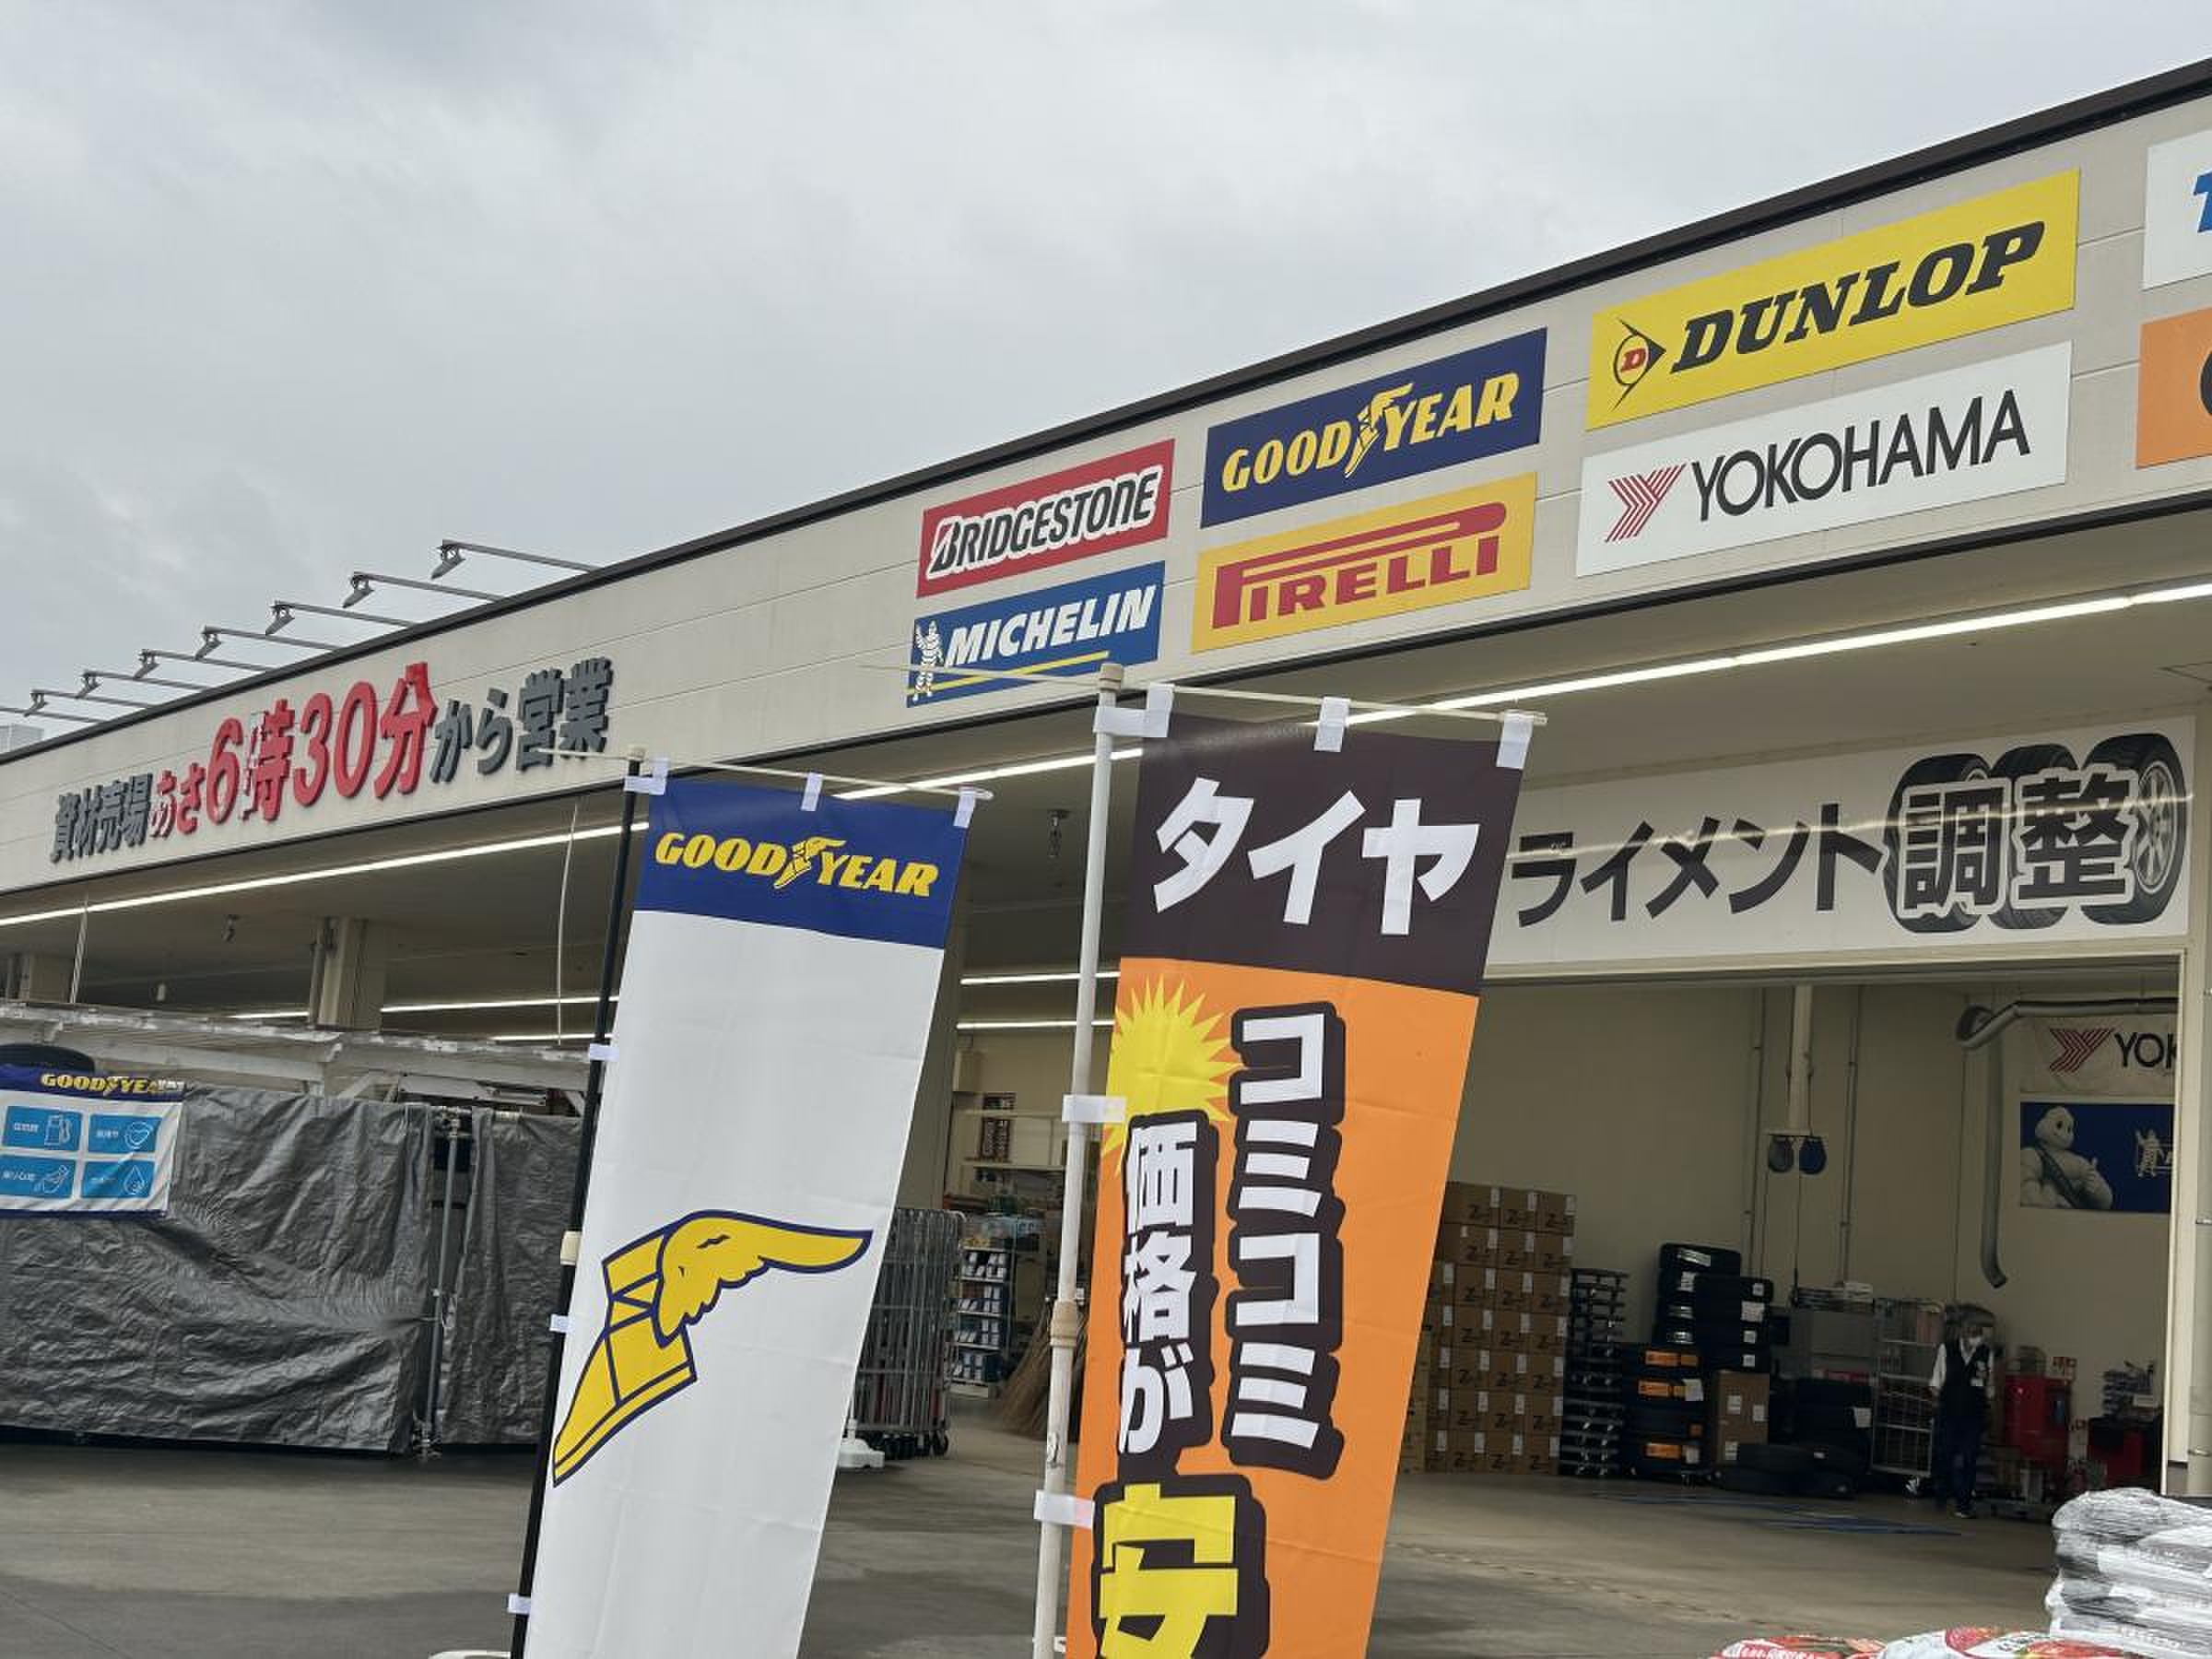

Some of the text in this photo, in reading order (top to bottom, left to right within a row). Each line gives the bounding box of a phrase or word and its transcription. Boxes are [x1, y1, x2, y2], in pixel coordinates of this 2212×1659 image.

[1670, 220, 2045, 372] DUNLOP
[1221, 372, 1520, 492] GOODYEAR
[1691, 389, 2031, 522] YOKOHAMA
[927, 468, 1161, 576] BRIDGESTONE
[1212, 502, 1506, 629] PIRELLI
[944, 584, 1157, 667] MICHELIN
[655, 832, 939, 898] GOODYEAR
[1153, 777, 1480, 935] タイヤ
[1231, 1013, 1325, 1449] コミコミ
